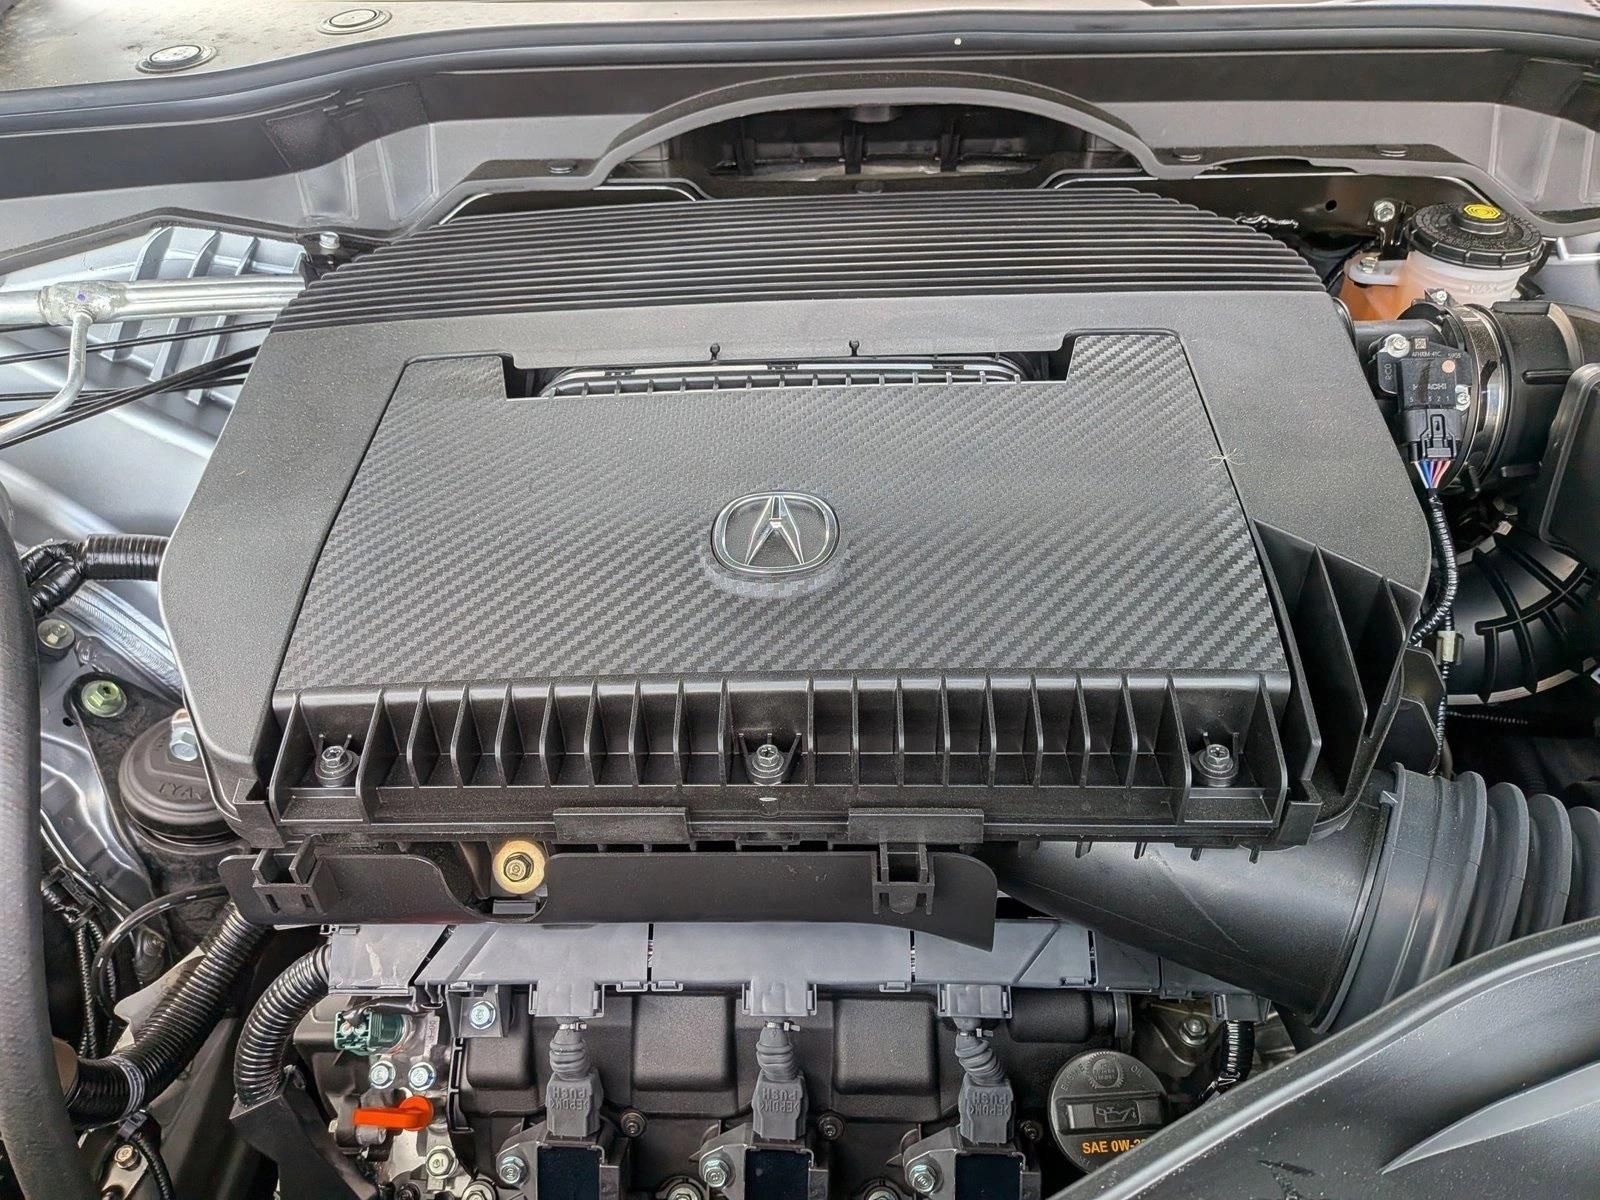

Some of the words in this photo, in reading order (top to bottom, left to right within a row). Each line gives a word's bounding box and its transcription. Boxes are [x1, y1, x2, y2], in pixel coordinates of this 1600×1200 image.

[1130, 1065, 1144, 1079] OIL
[553, 1087, 588, 1099] PUSH
[762, 1088, 799, 1100] PUSH
[972, 1092, 1009, 1104] PUSH
[1082, 1142, 1109, 1155] SAE
[1110, 1138, 1147, 1153] 0W-2
